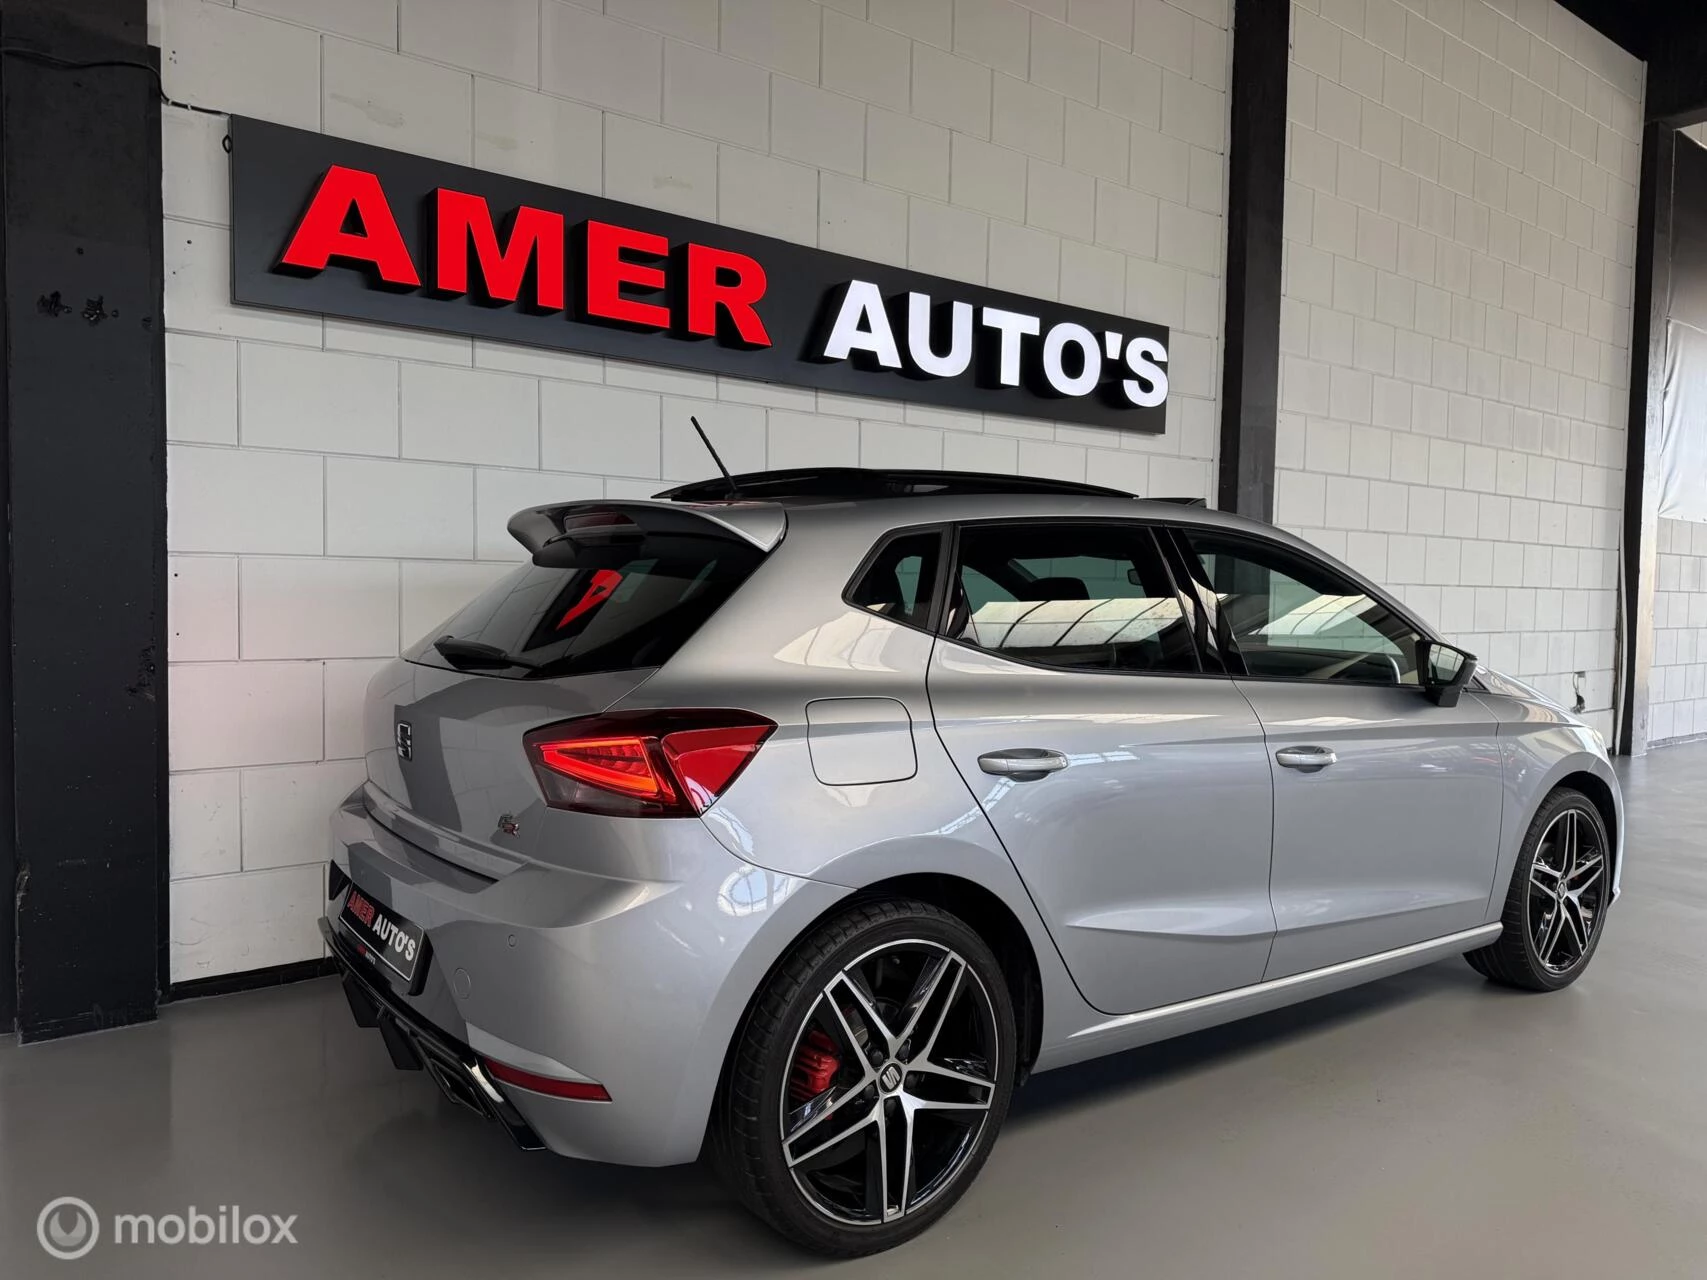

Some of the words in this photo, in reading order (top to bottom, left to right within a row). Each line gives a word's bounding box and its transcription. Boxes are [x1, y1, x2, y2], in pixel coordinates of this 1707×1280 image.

[281, 164, 773, 346] AMER
[823, 279, 1169, 408] AUTO'S
[347, 890, 375, 928] AMER
[372, 913, 416, 961] AUTO'S
